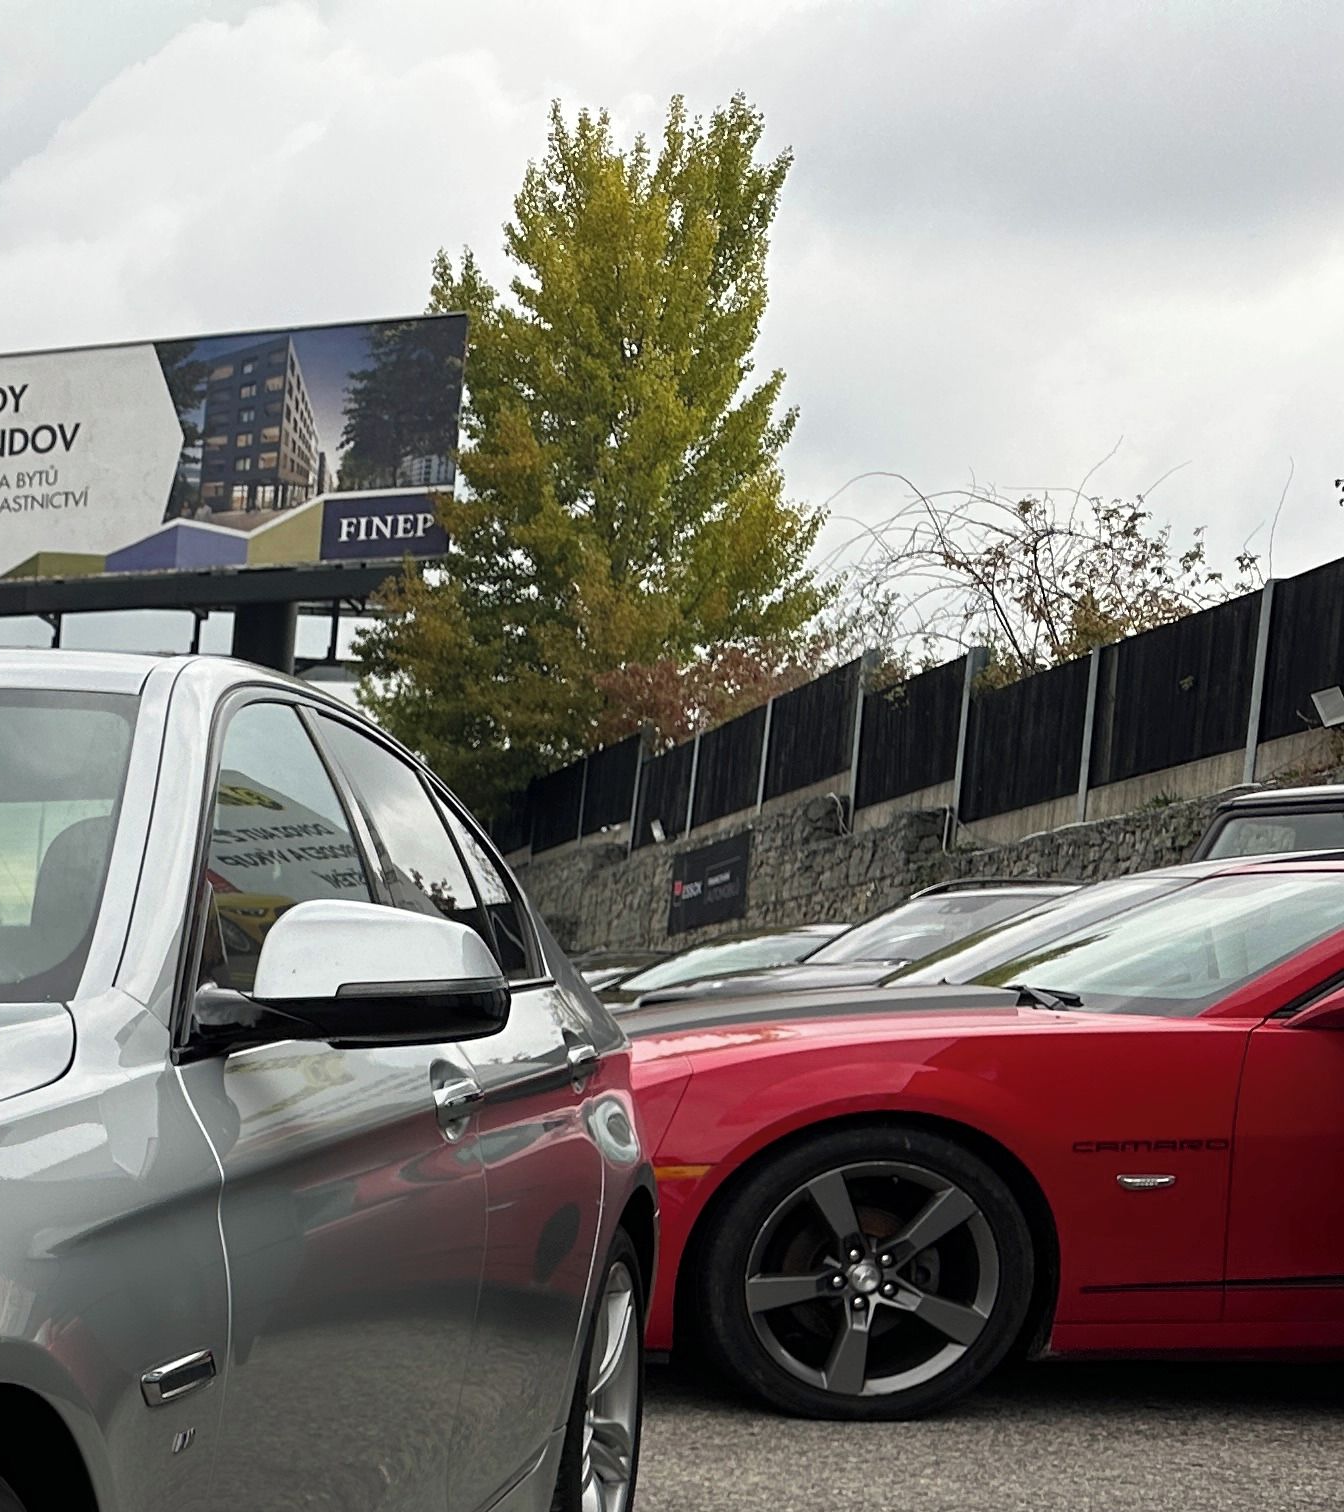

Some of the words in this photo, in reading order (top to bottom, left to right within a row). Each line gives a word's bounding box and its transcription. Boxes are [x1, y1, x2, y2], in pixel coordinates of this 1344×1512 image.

[16, 466, 59, 489] BYTŮ
[338, 511, 435, 542] FINEP
[1072, 1138, 1229, 1152] CAMARO
